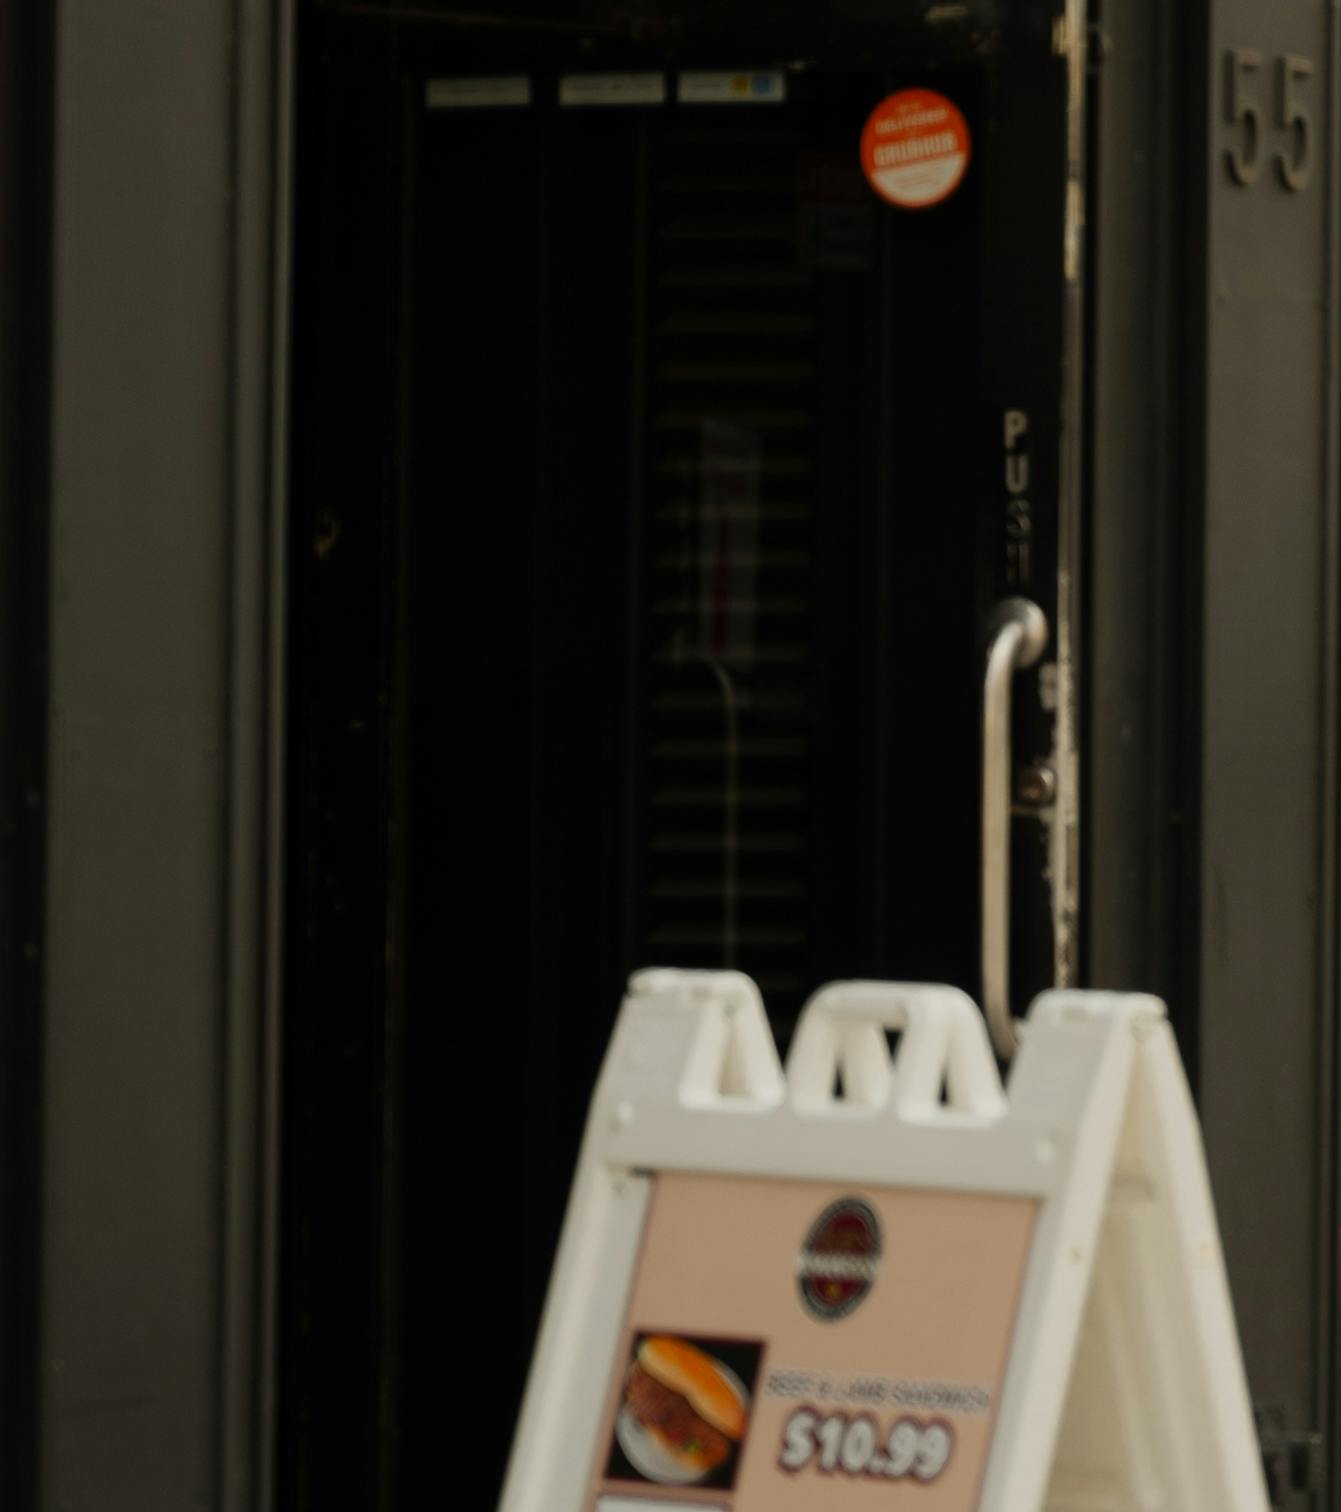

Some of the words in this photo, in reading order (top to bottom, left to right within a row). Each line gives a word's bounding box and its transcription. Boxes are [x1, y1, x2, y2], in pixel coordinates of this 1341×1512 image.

[1222, 47, 1315, 196] 55
[1004, 409, 1032, 584] PUSH
[779, 1404, 955, 1484] $10.99
